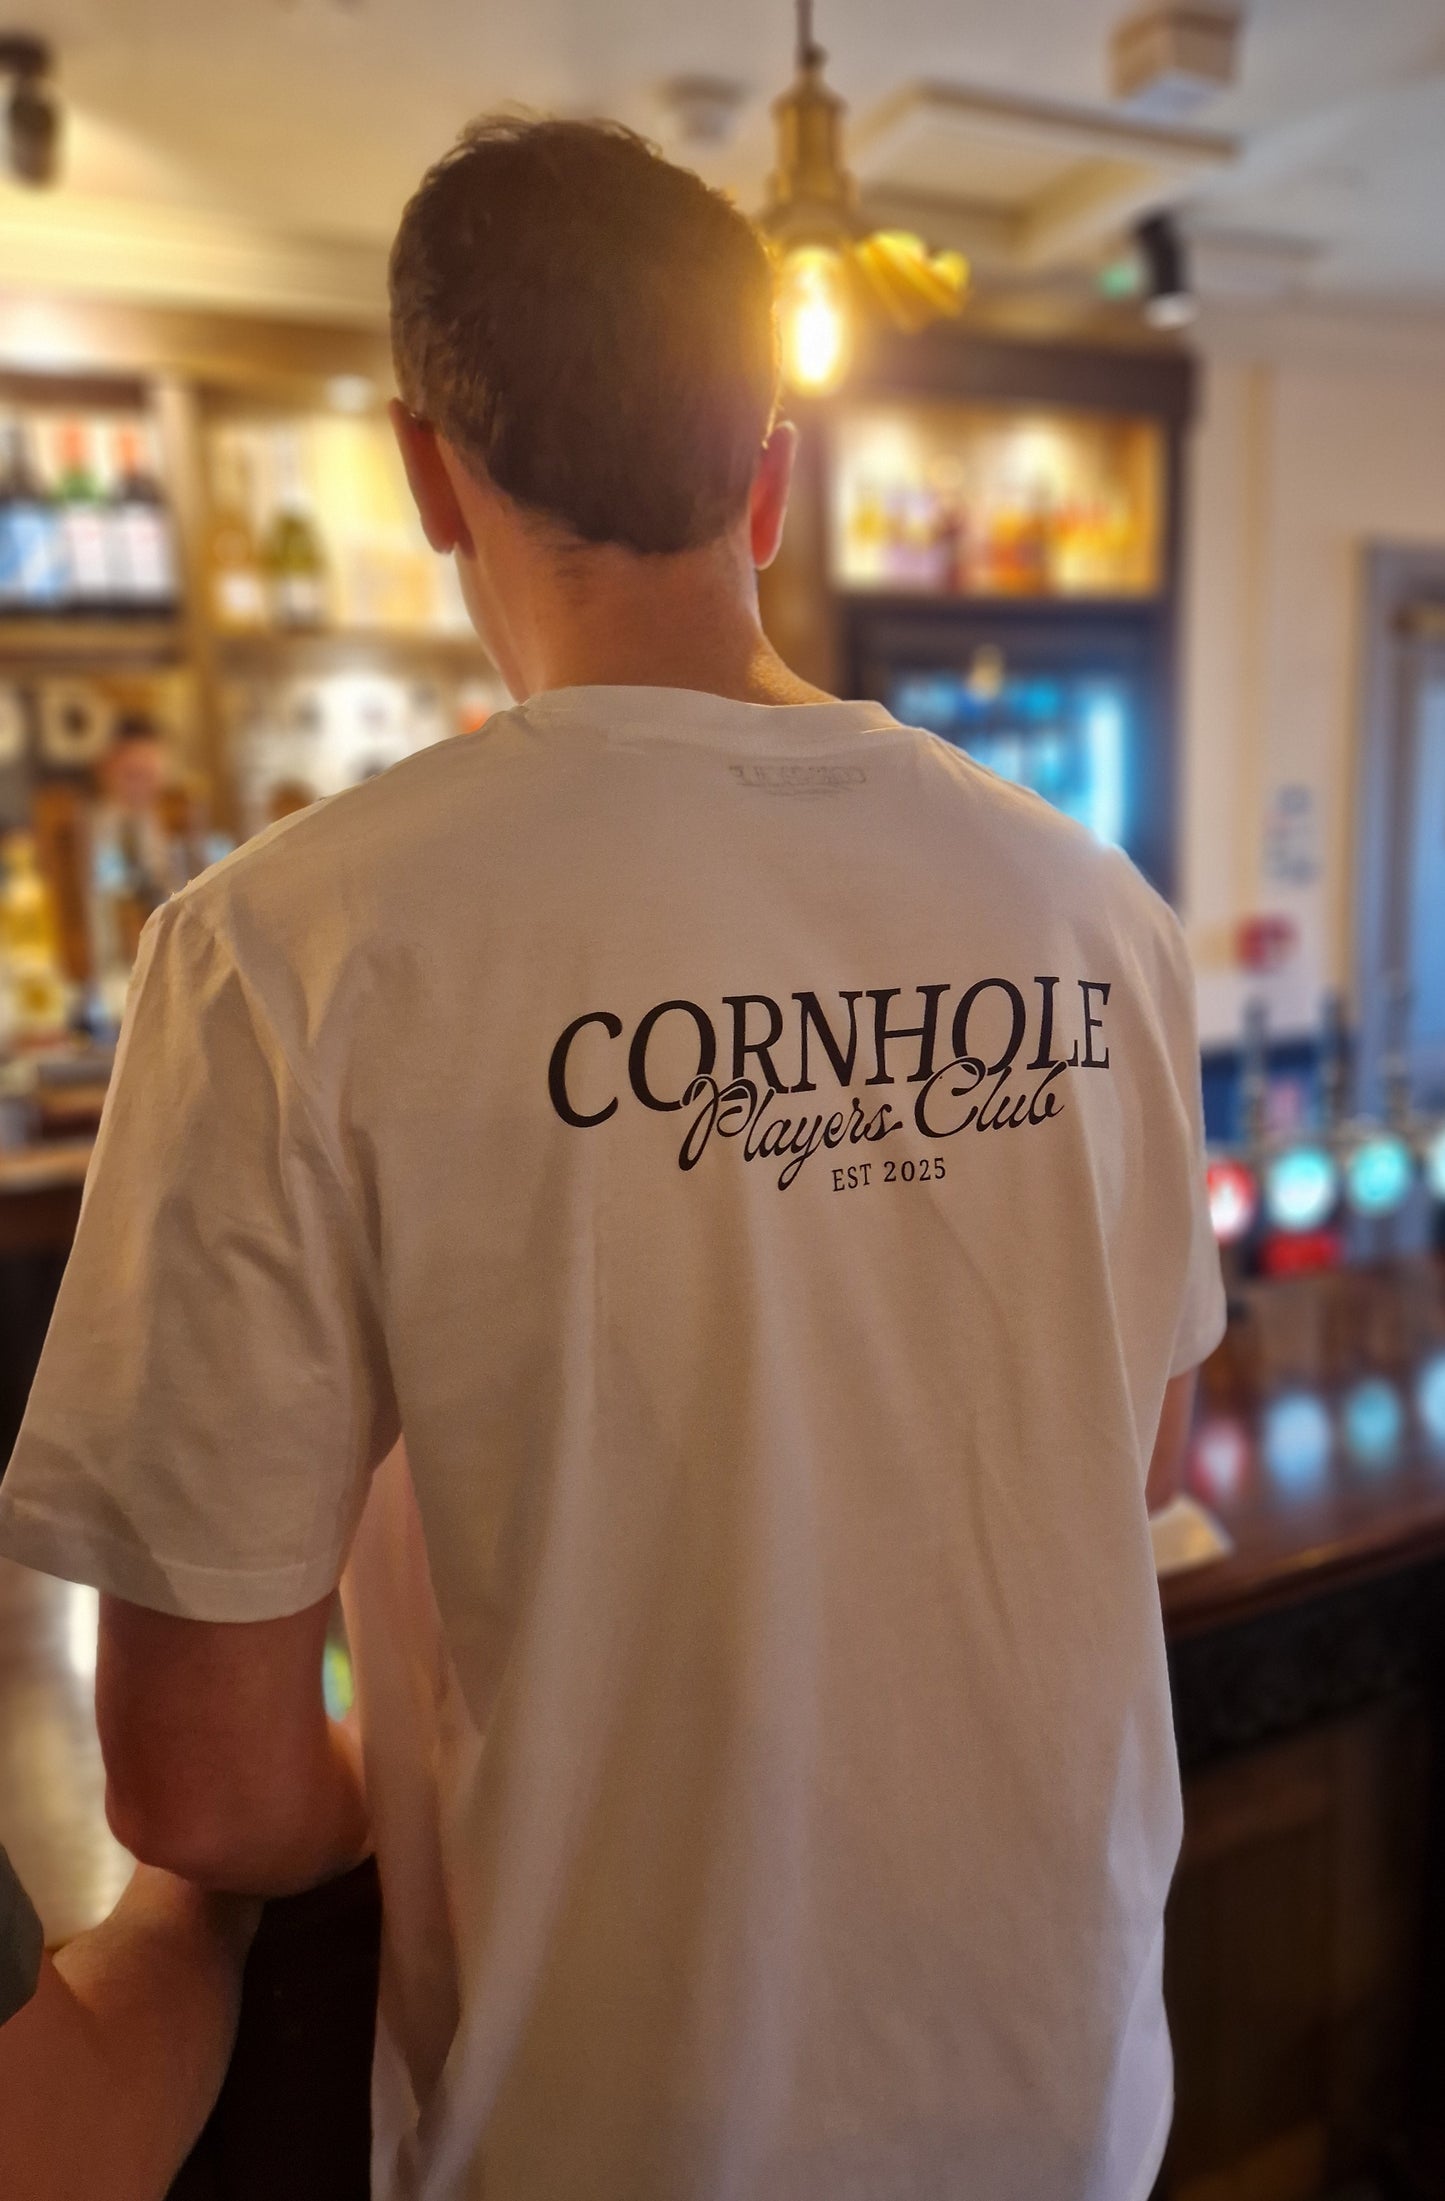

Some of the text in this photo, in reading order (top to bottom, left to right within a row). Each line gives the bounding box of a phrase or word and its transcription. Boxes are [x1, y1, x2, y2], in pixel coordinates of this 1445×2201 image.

[548, 976, 1111, 1129] CORNHOLE
[678, 1056, 1069, 1192] Players Club
[831, 1157, 947, 1192] EST 2025
